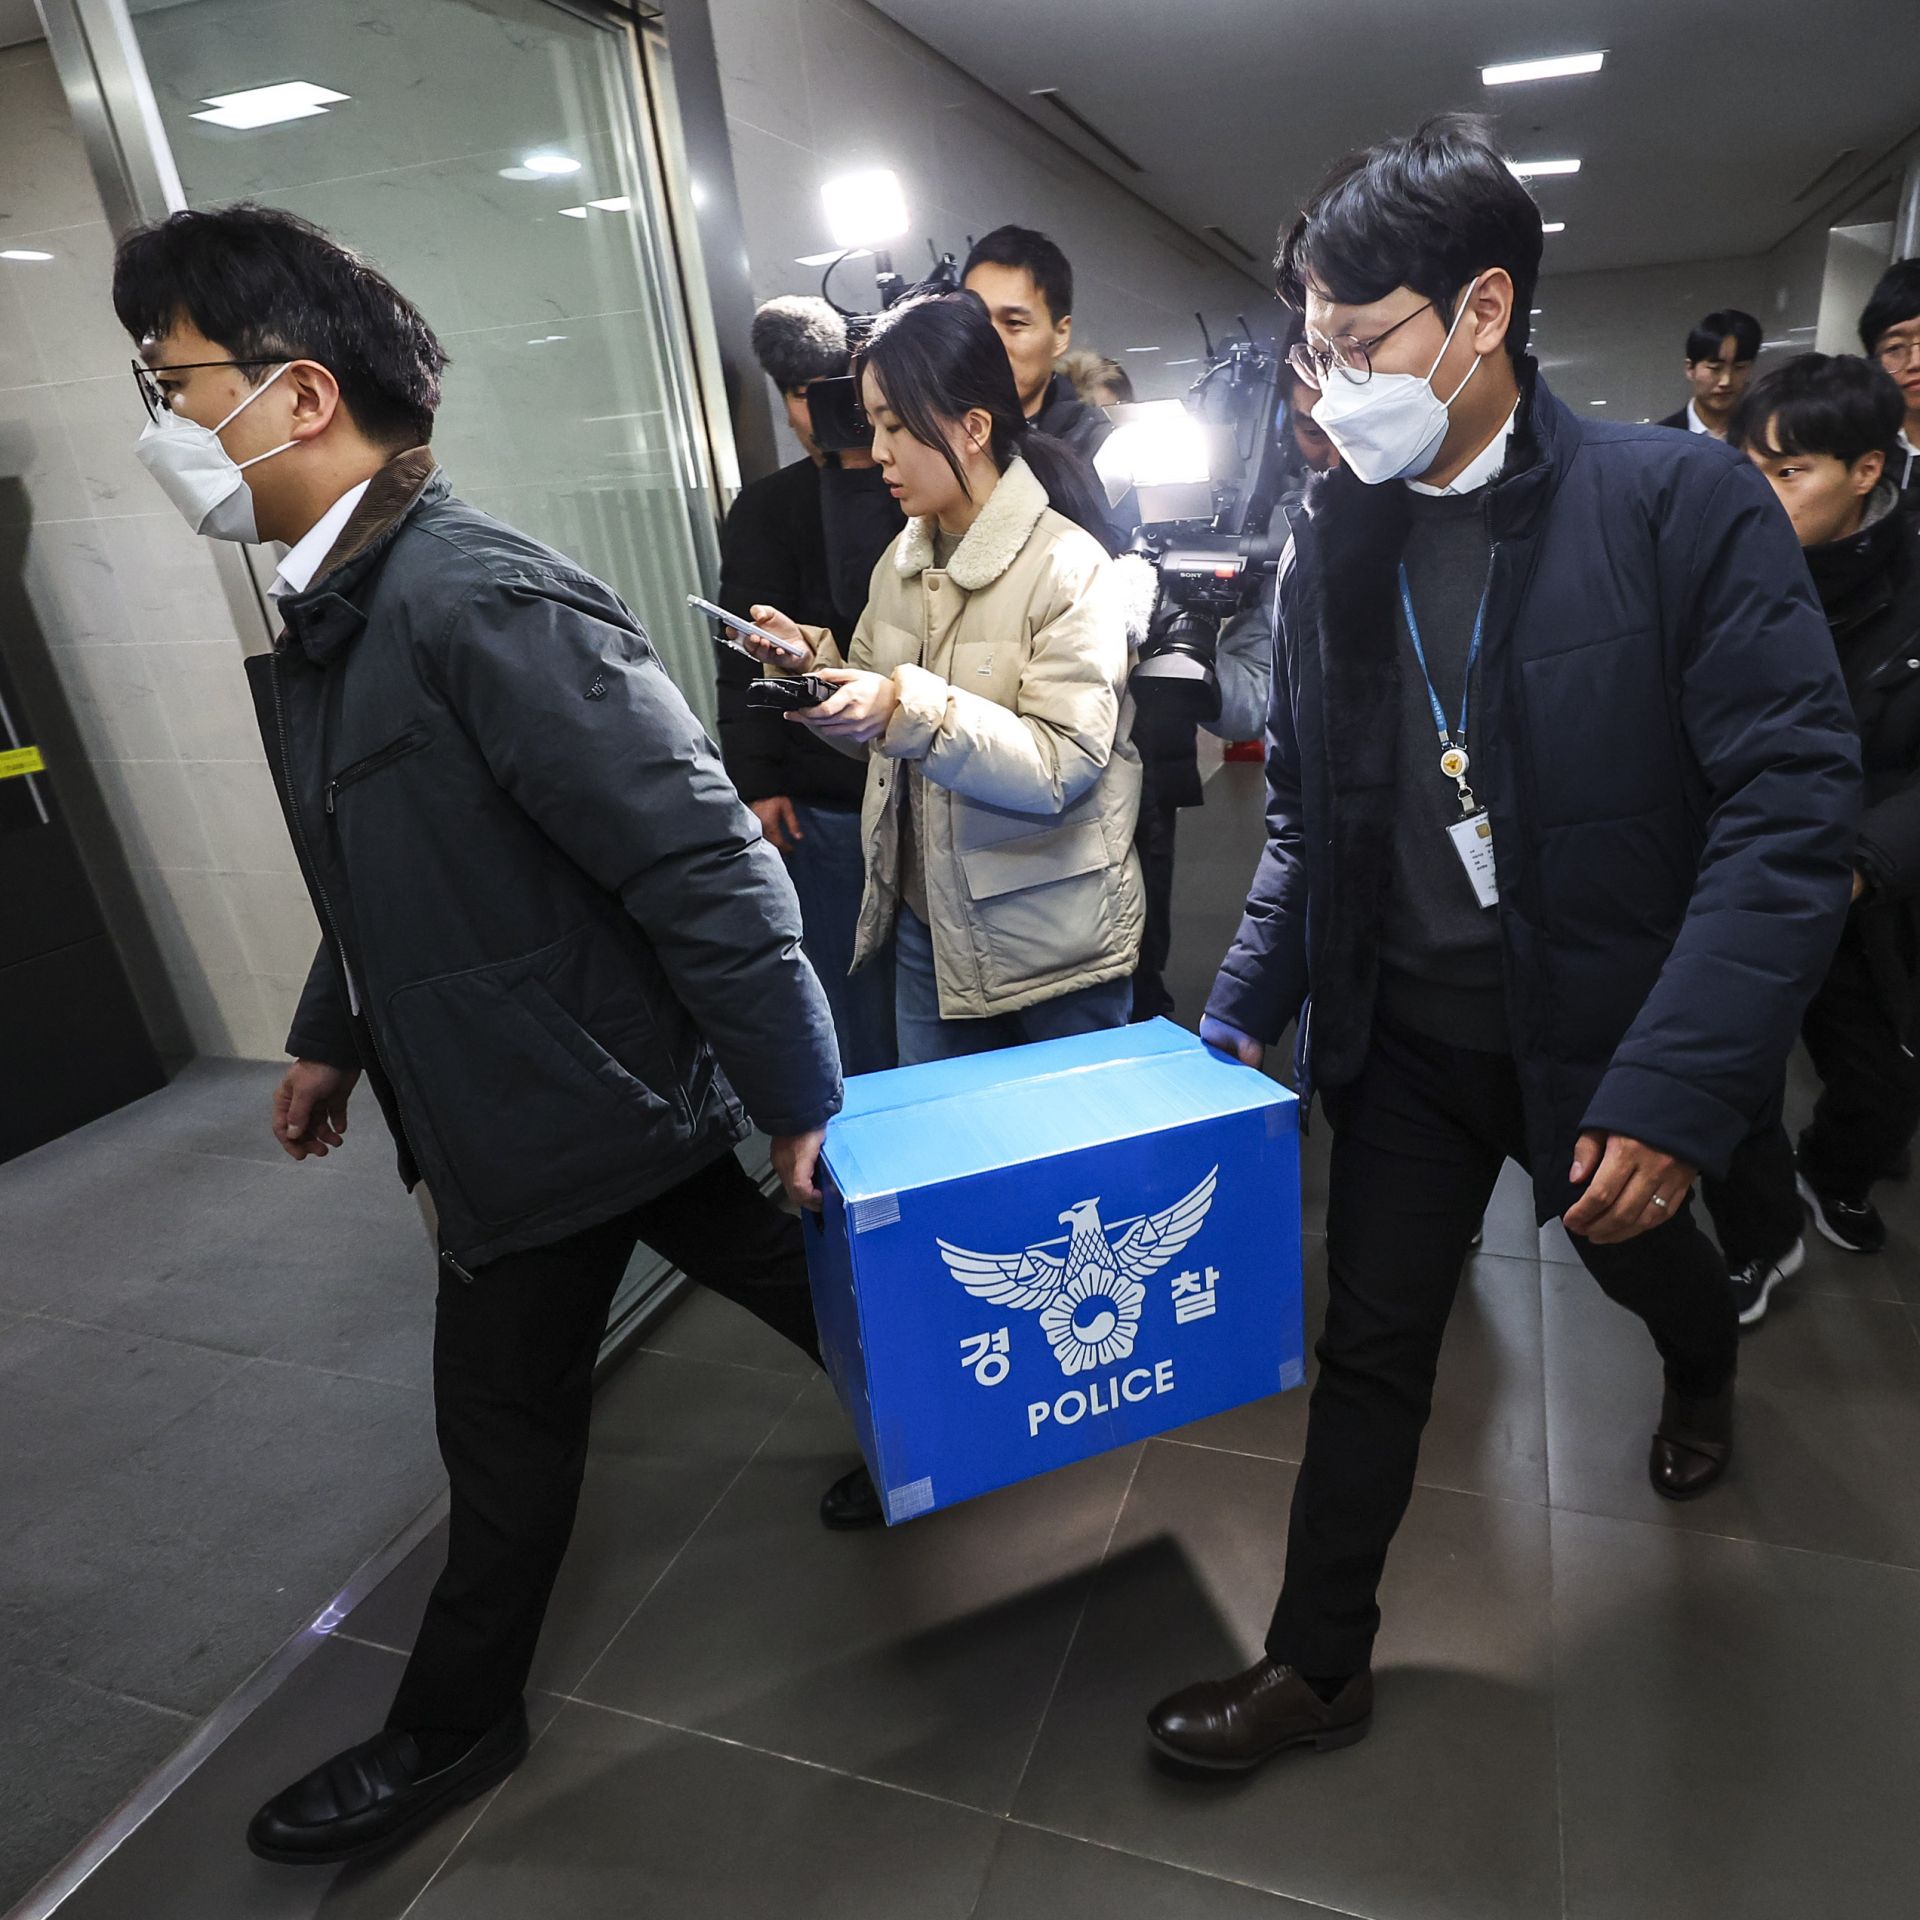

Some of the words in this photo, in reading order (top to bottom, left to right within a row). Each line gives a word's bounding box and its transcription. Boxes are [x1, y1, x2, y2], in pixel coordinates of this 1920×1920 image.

[959, 1326, 1011, 1387] 경
[1171, 1266, 1220, 1325] 찰
[1027, 1359, 1175, 1437] POLICE
